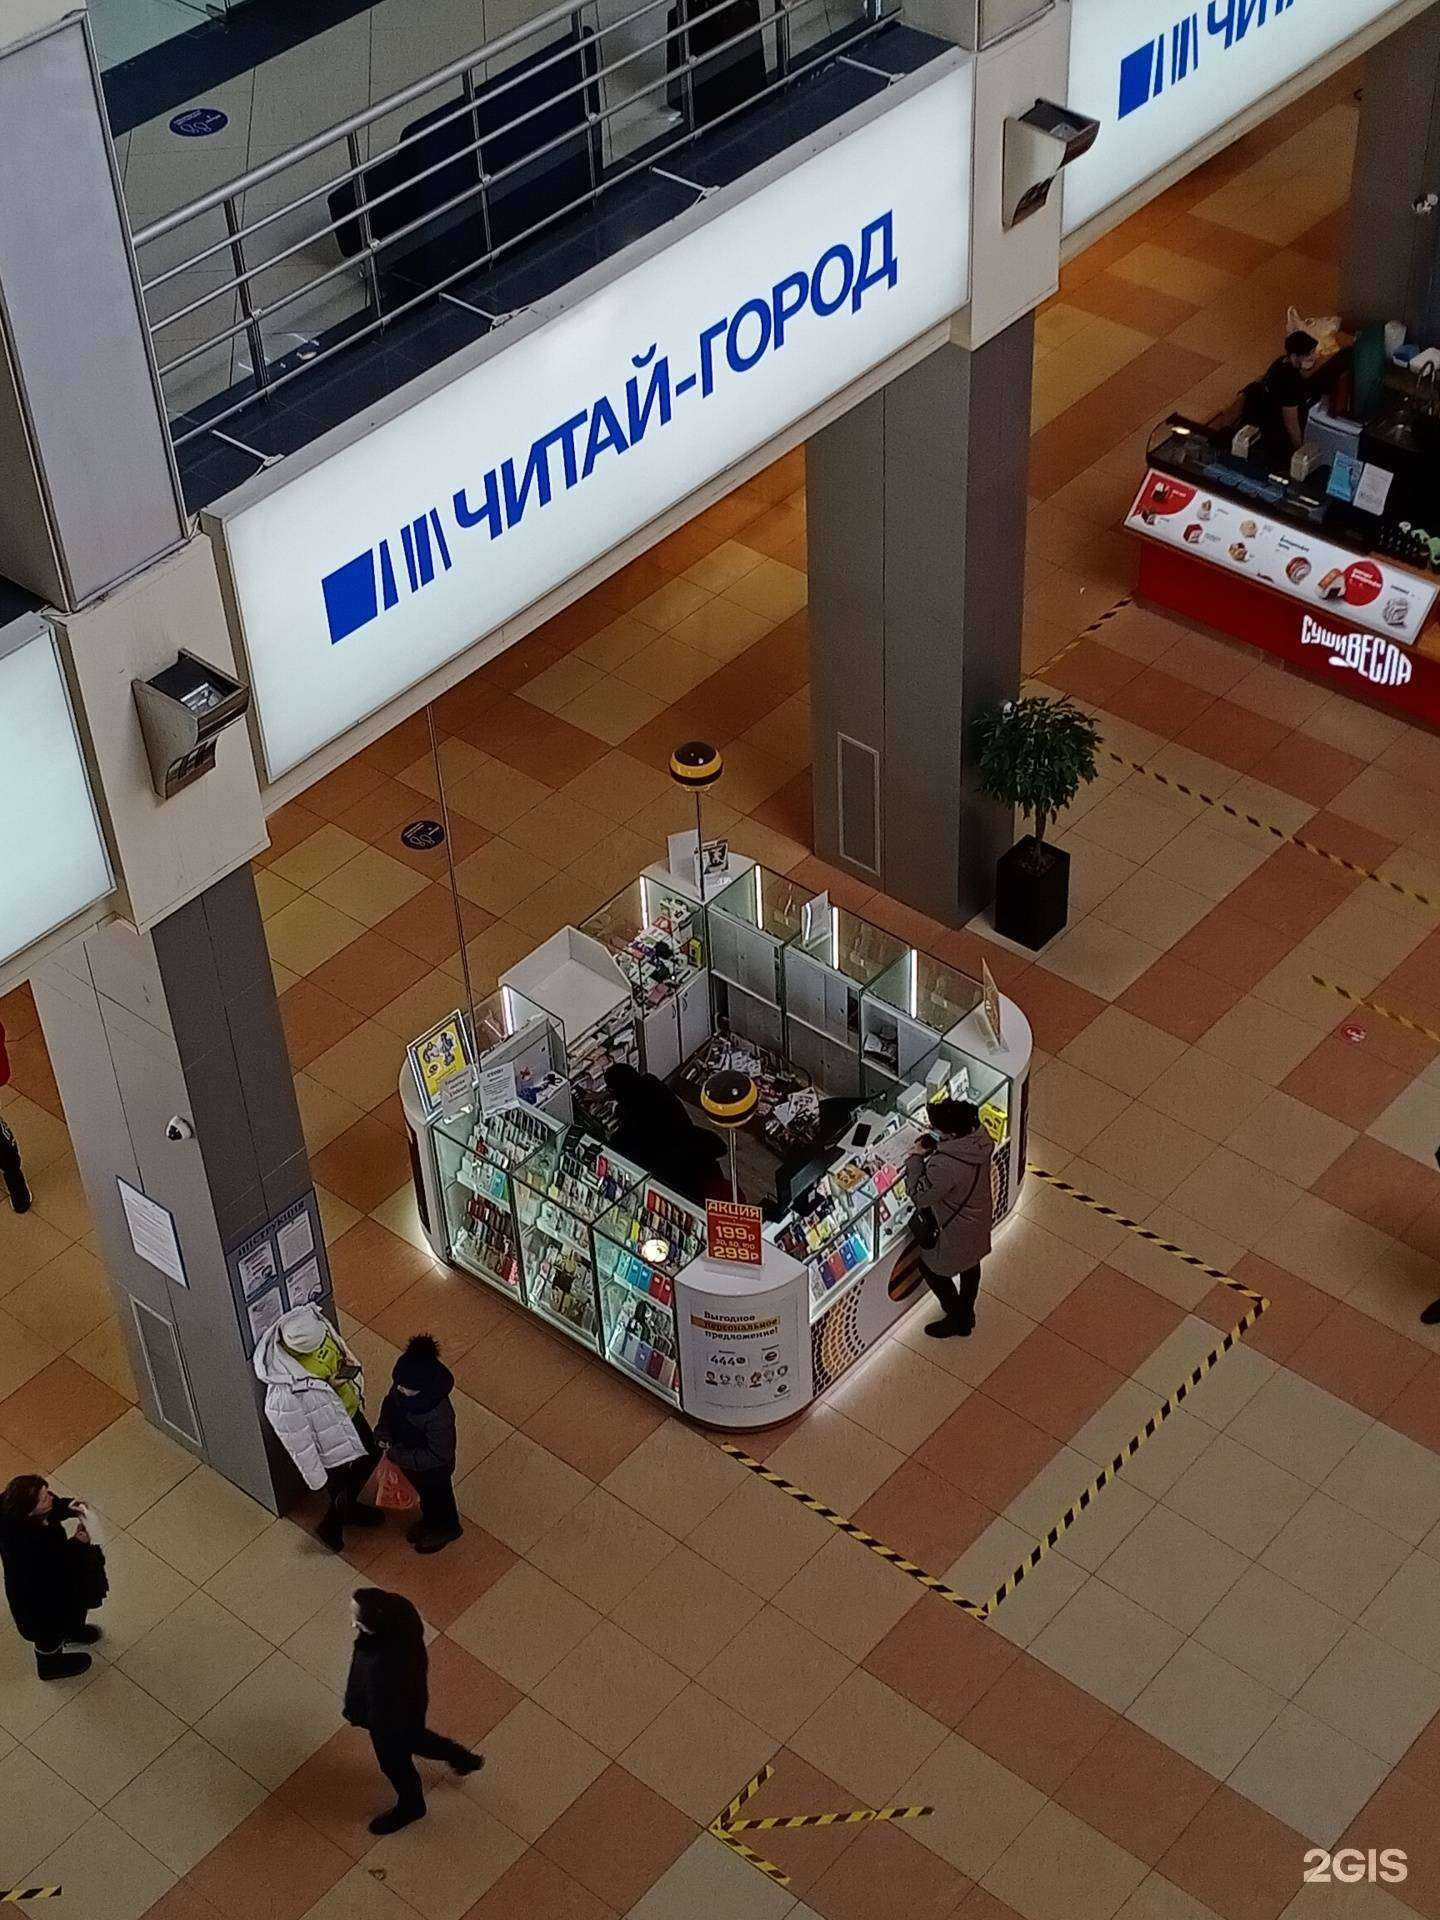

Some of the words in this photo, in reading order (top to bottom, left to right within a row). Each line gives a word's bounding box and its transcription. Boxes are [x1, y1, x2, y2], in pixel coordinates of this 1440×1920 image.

[452, 209, 897, 541] ЧИТАЙ-ГОРОД
[708, 1202, 760, 1218] АКЦИЯ
[704, 1310, 756, 1323] Выгодное
